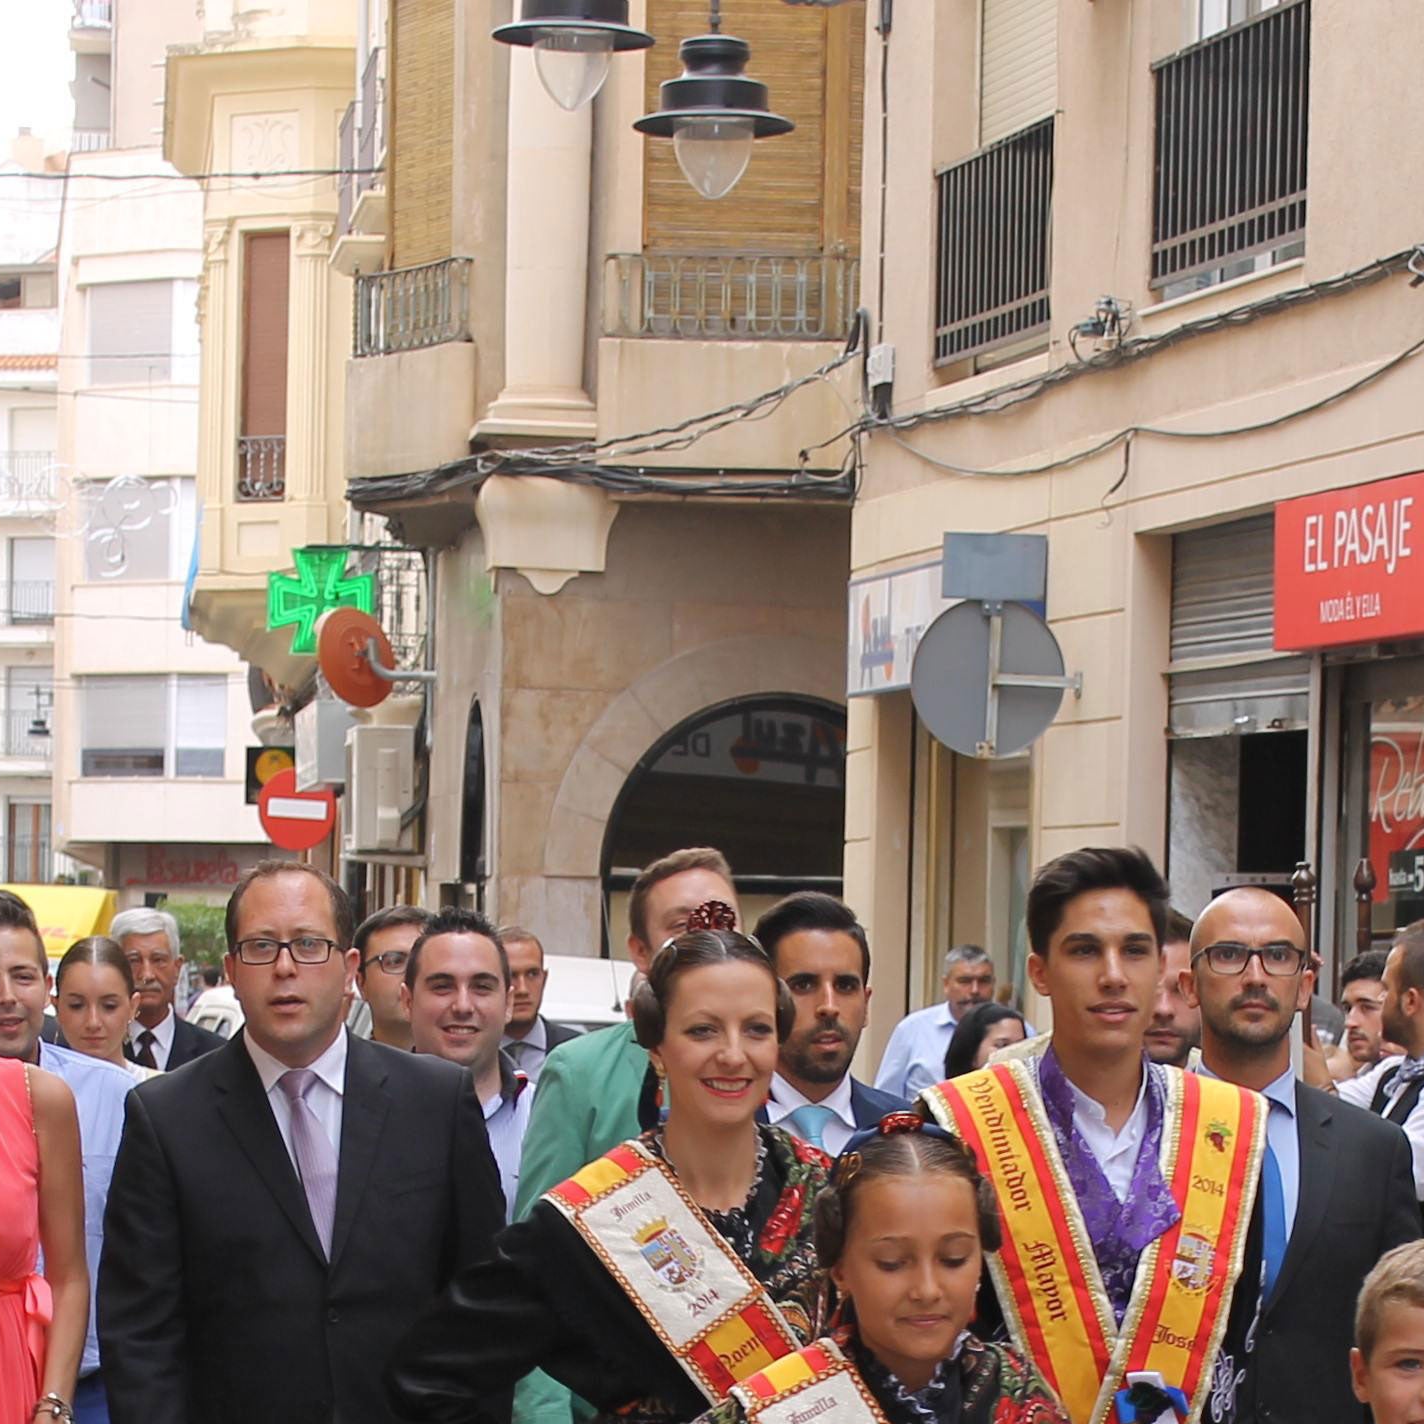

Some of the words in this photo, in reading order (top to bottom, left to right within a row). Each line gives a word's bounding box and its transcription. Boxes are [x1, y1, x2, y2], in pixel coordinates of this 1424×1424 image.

[1304, 514, 1328, 573] EL
[1333, 497, 1414, 575] PASAJE
[1319, 599, 1344, 623] MODA
[1361, 592, 1381, 617] ELLA
[967, 1077, 1032, 1212] Vendimiador
[1023, 1240, 1068, 1322] Mayor
[1192, 1174, 1225, 1197] 2014
[610, 1191, 652, 1221] Jumilla
[687, 1288, 721, 1318] 2014
